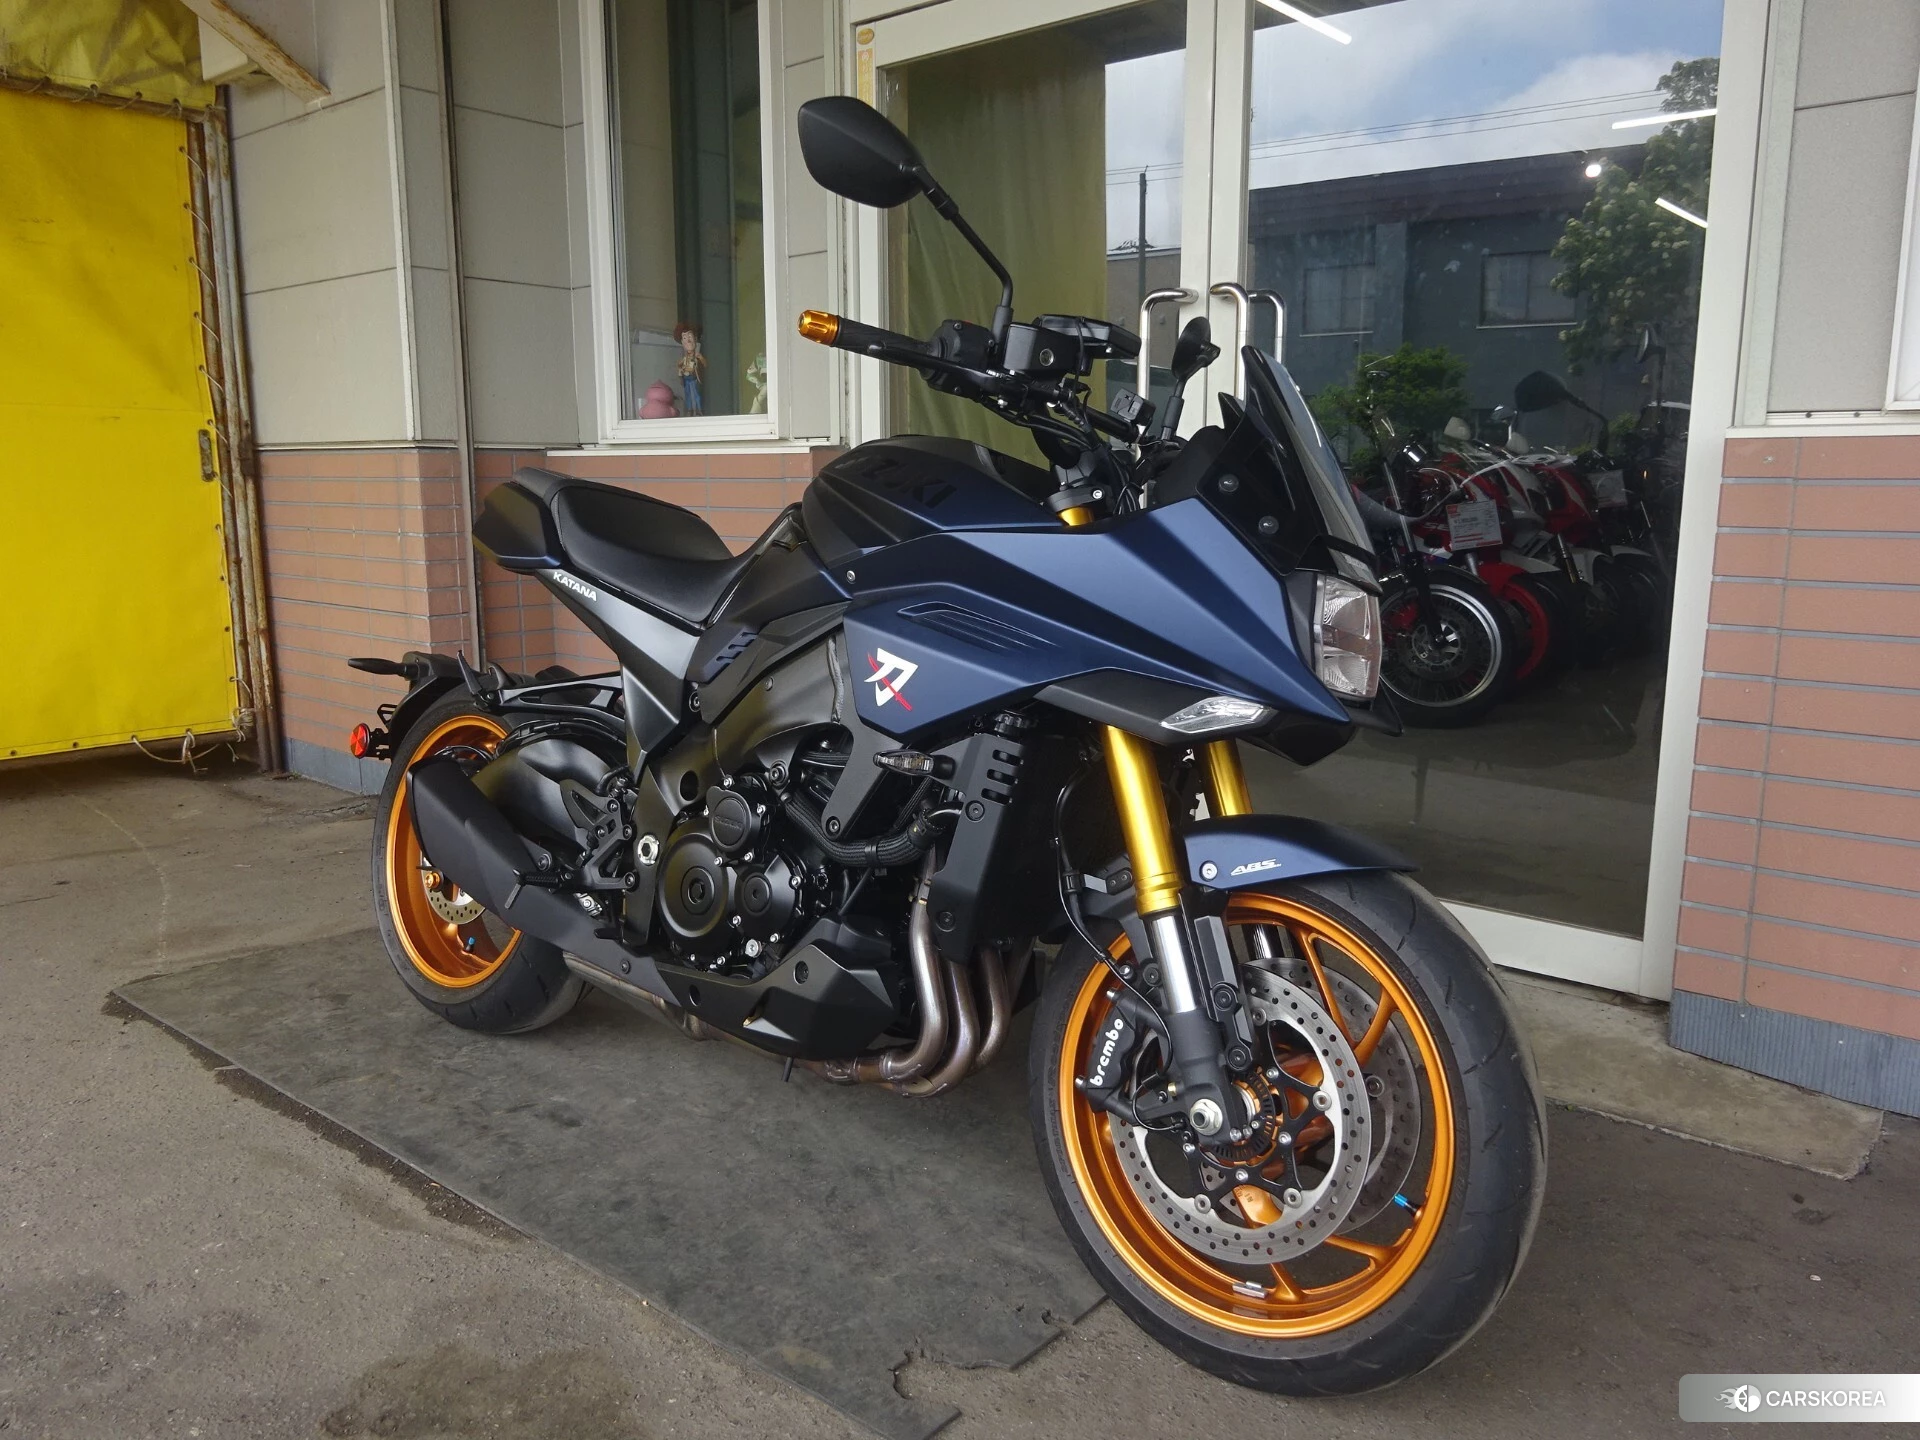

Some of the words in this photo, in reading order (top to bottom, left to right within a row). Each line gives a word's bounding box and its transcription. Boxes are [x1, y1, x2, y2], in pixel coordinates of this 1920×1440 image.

[553, 571, 597, 602] KATANA
[1230, 858, 1278, 877] ABS
[1089, 1018, 1124, 1087] brembo
